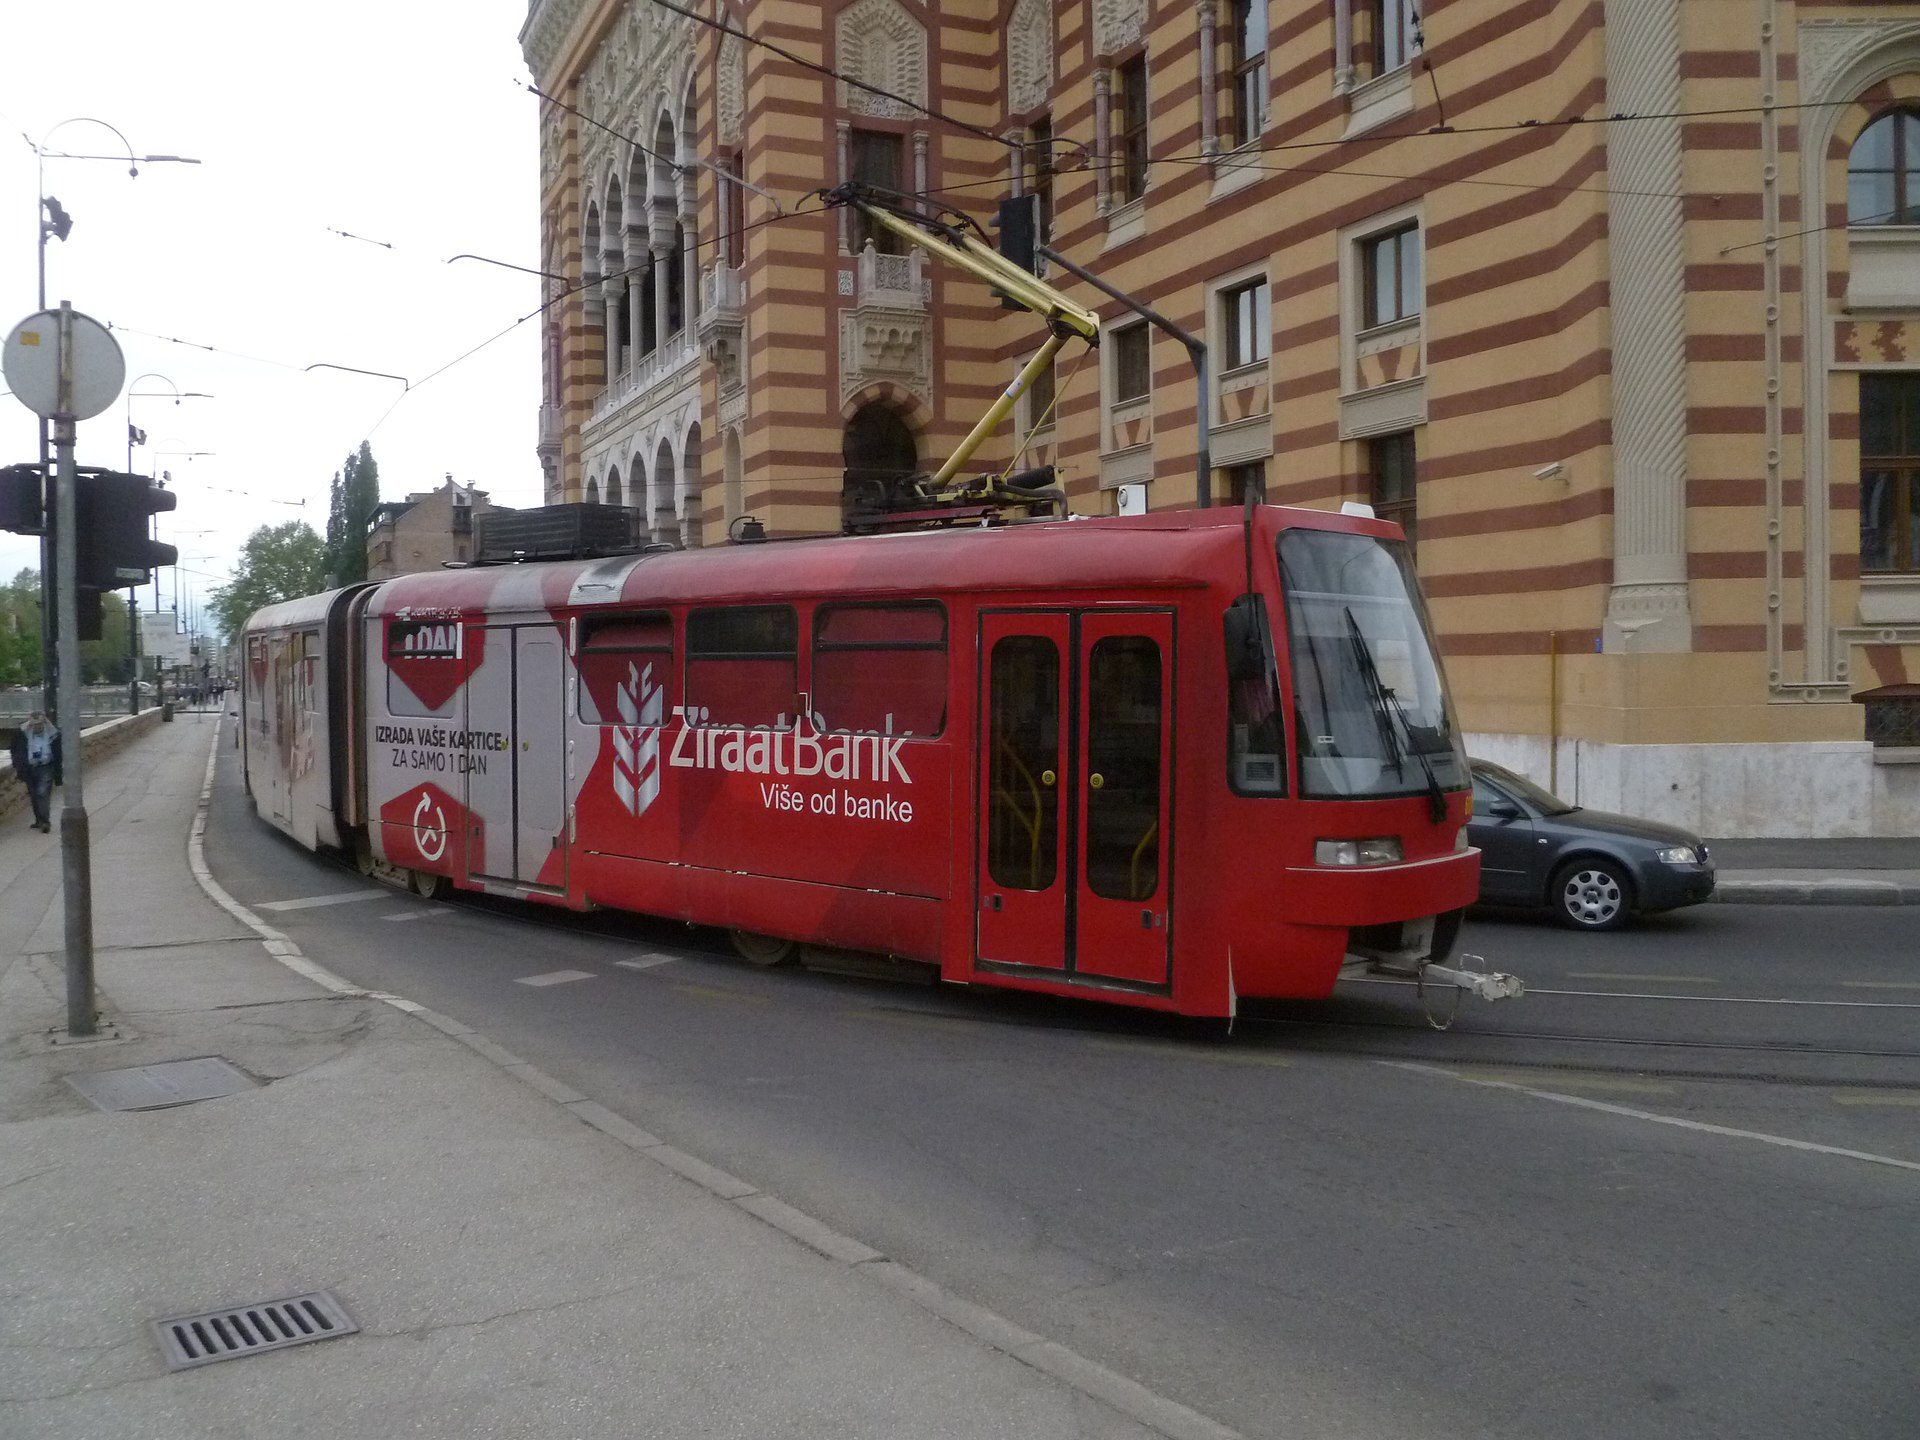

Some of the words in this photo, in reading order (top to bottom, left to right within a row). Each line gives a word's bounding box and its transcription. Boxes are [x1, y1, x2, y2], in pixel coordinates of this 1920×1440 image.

[375, 726, 414, 744] IZRADA
[417, 725, 446, 747] VAŠE
[449, 730, 502, 751] KARTICE
[669, 706, 913, 784] ZiraatBank
[392, 748, 408, 768] ZA
[411, 749, 445, 772] SAMO
[449, 753, 454, 772] 1
[458, 754, 487, 775] DAN
[760, 782, 804, 811] Više
[810, 788, 836, 815] od
[844, 789, 913, 823] banke
